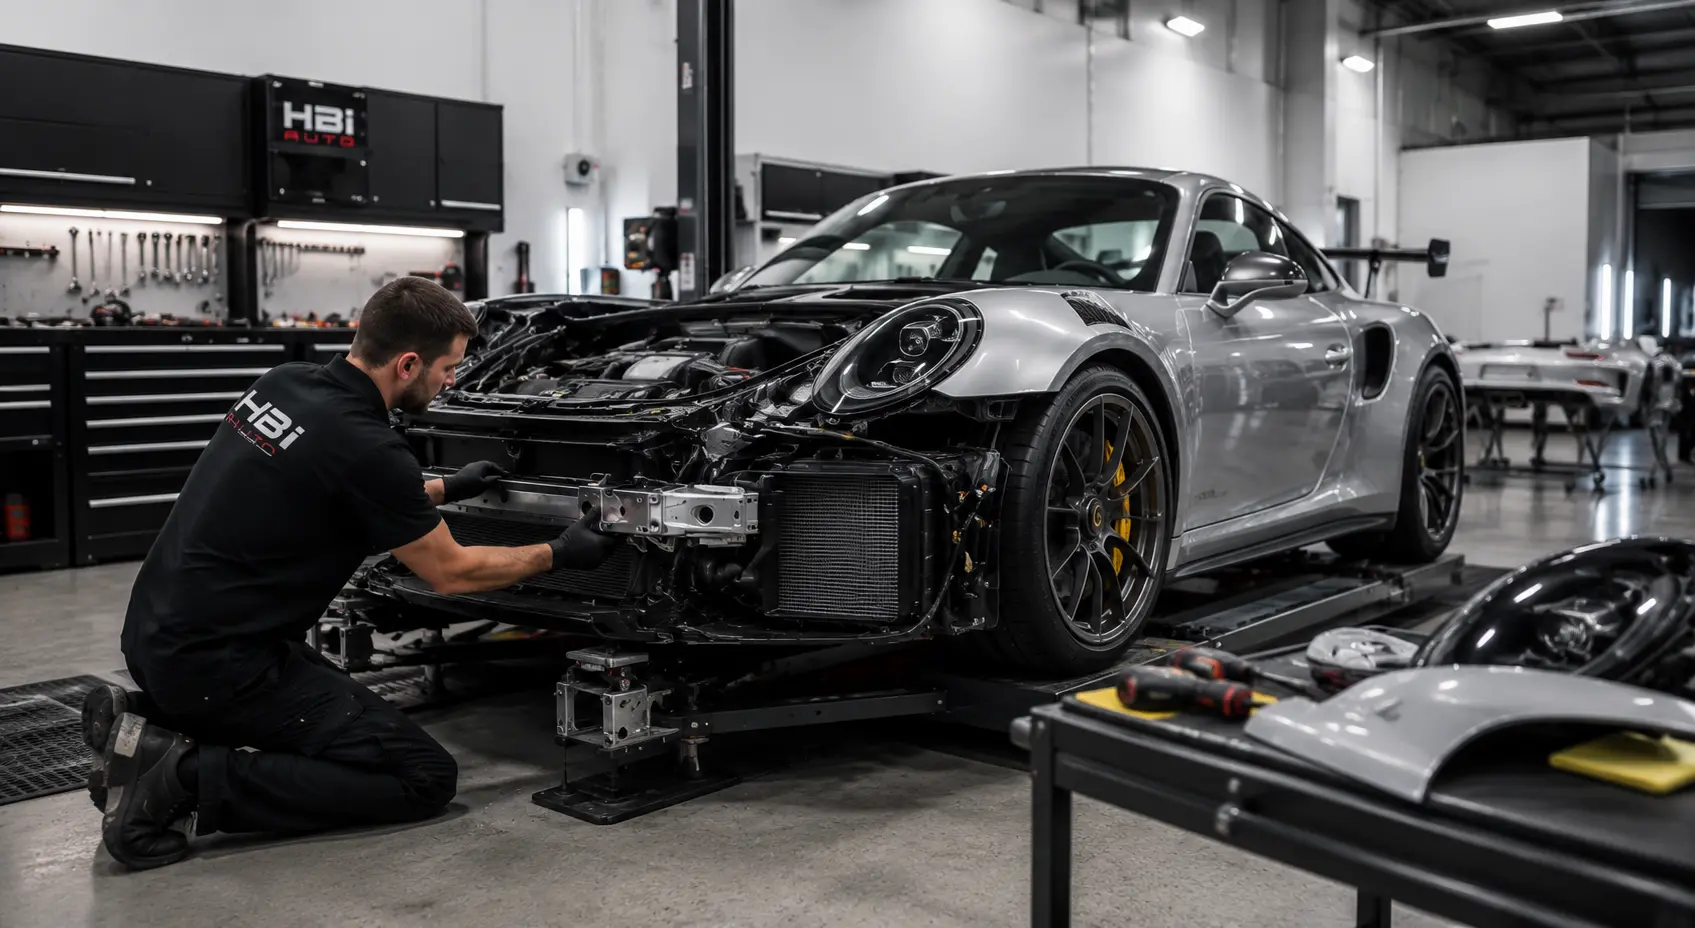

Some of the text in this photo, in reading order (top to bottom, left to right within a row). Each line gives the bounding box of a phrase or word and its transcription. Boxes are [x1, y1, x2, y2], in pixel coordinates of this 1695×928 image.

[283, 101, 355, 136] HBi
[284, 129, 355, 148] AUTO
[234, 389, 305, 450] HBi
